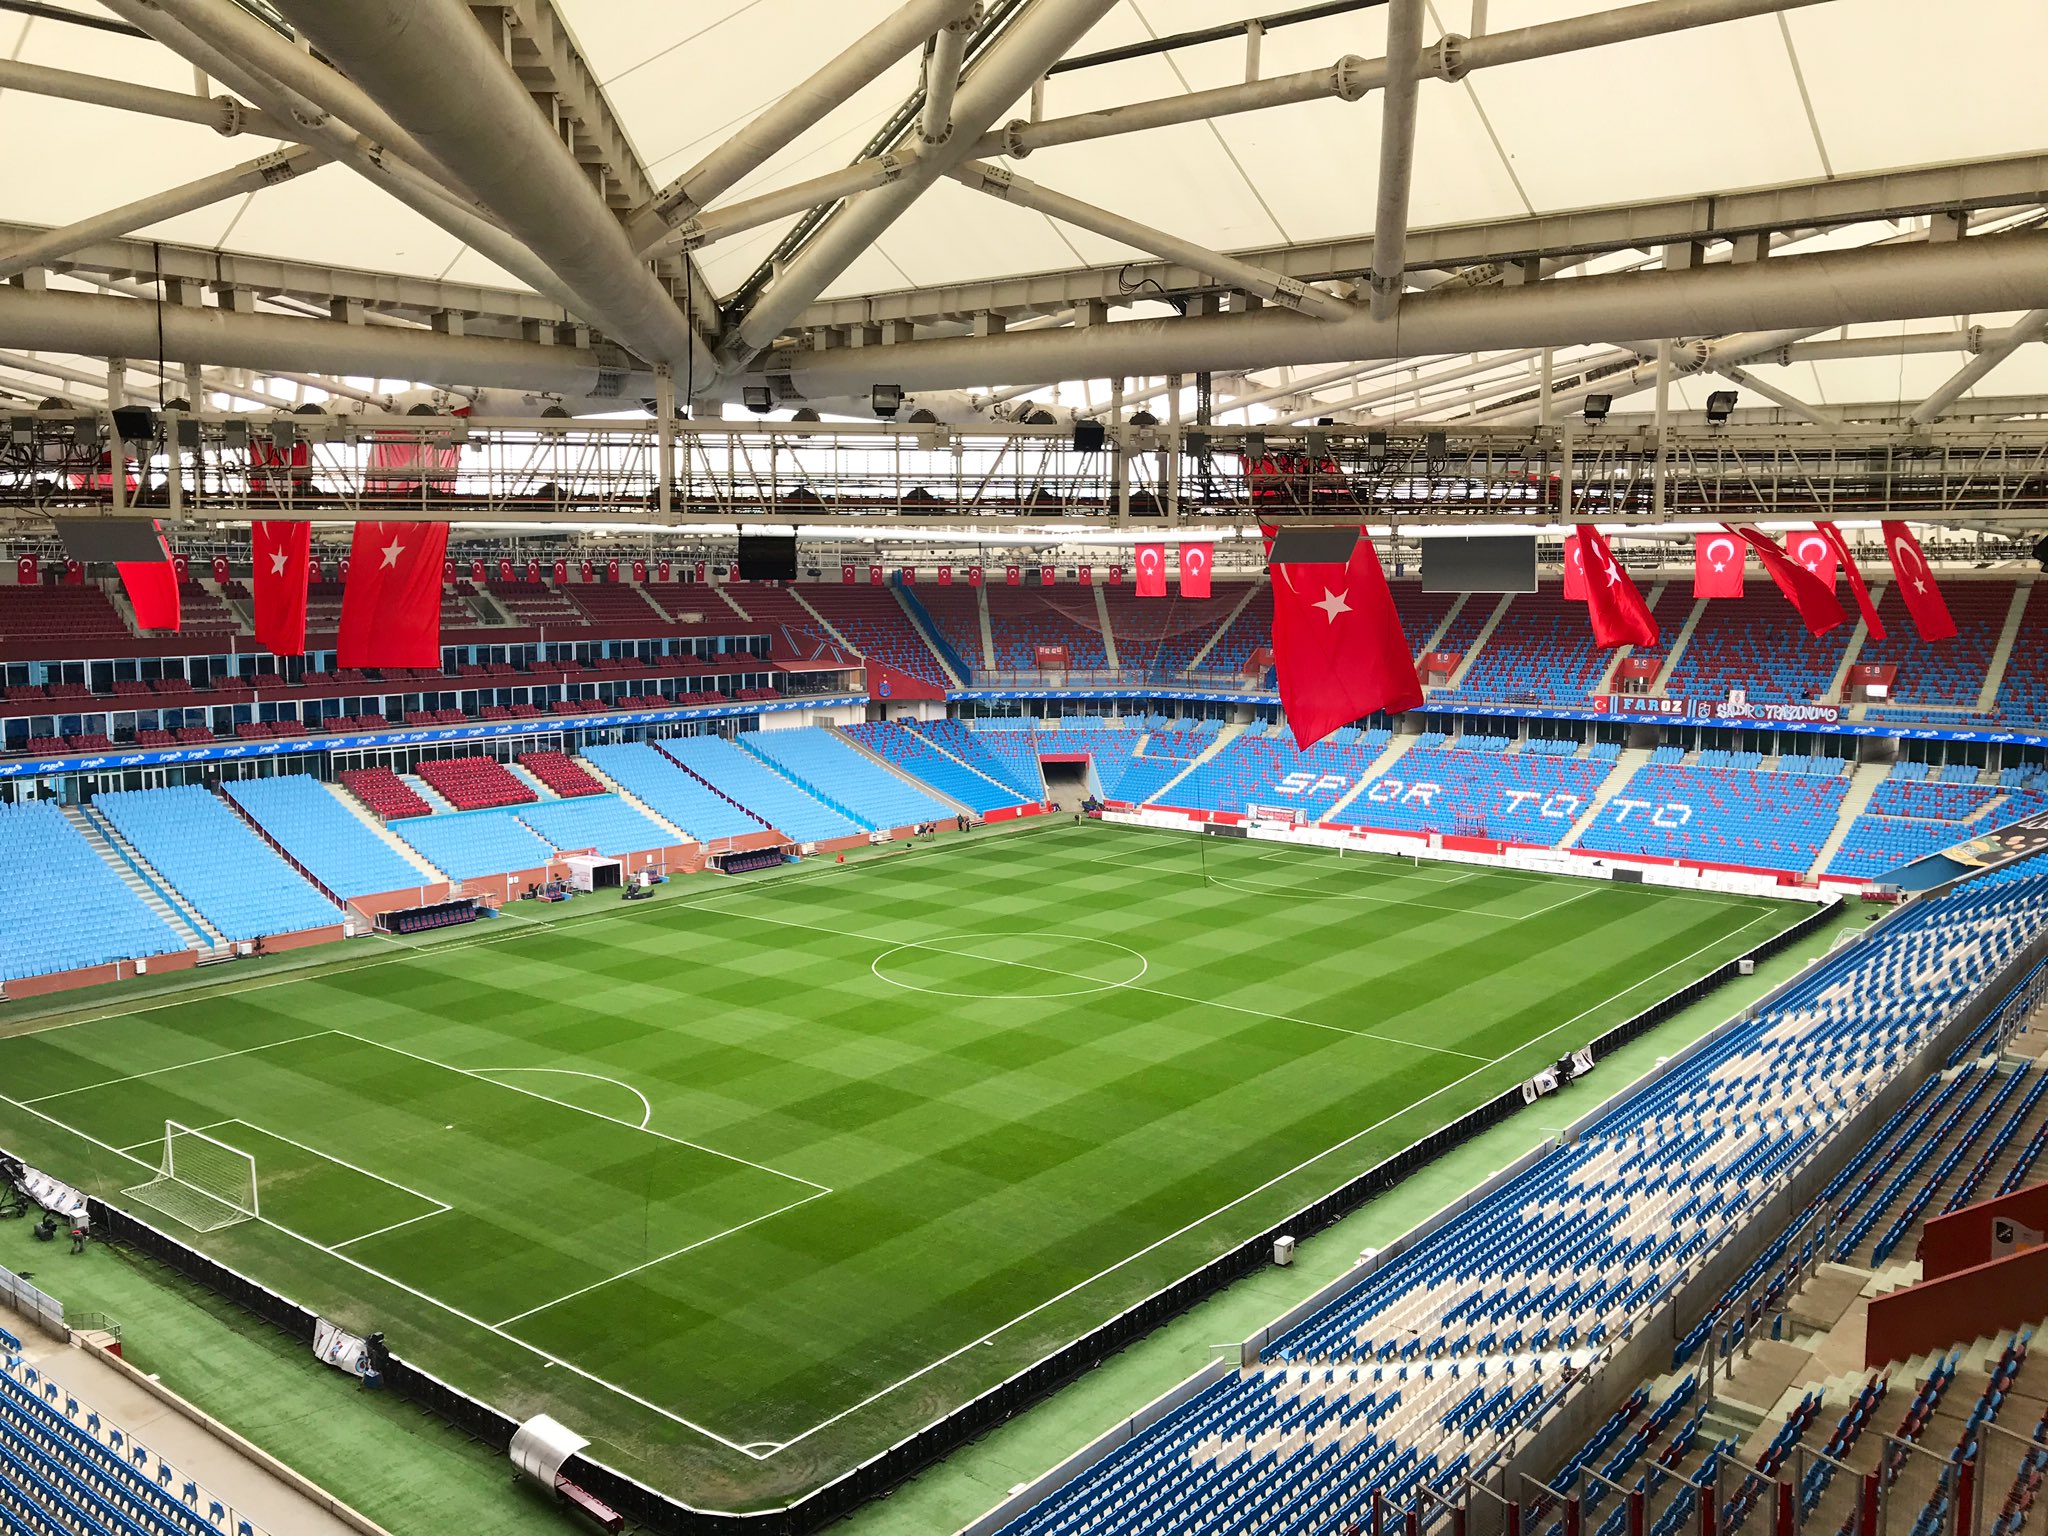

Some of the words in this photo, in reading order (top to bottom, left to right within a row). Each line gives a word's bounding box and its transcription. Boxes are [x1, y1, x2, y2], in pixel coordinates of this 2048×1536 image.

[1623, 698, 1682, 712] FAROZ
[1274, 772, 1441, 806] SPOR
[1505, 789, 1692, 828] TOTO
